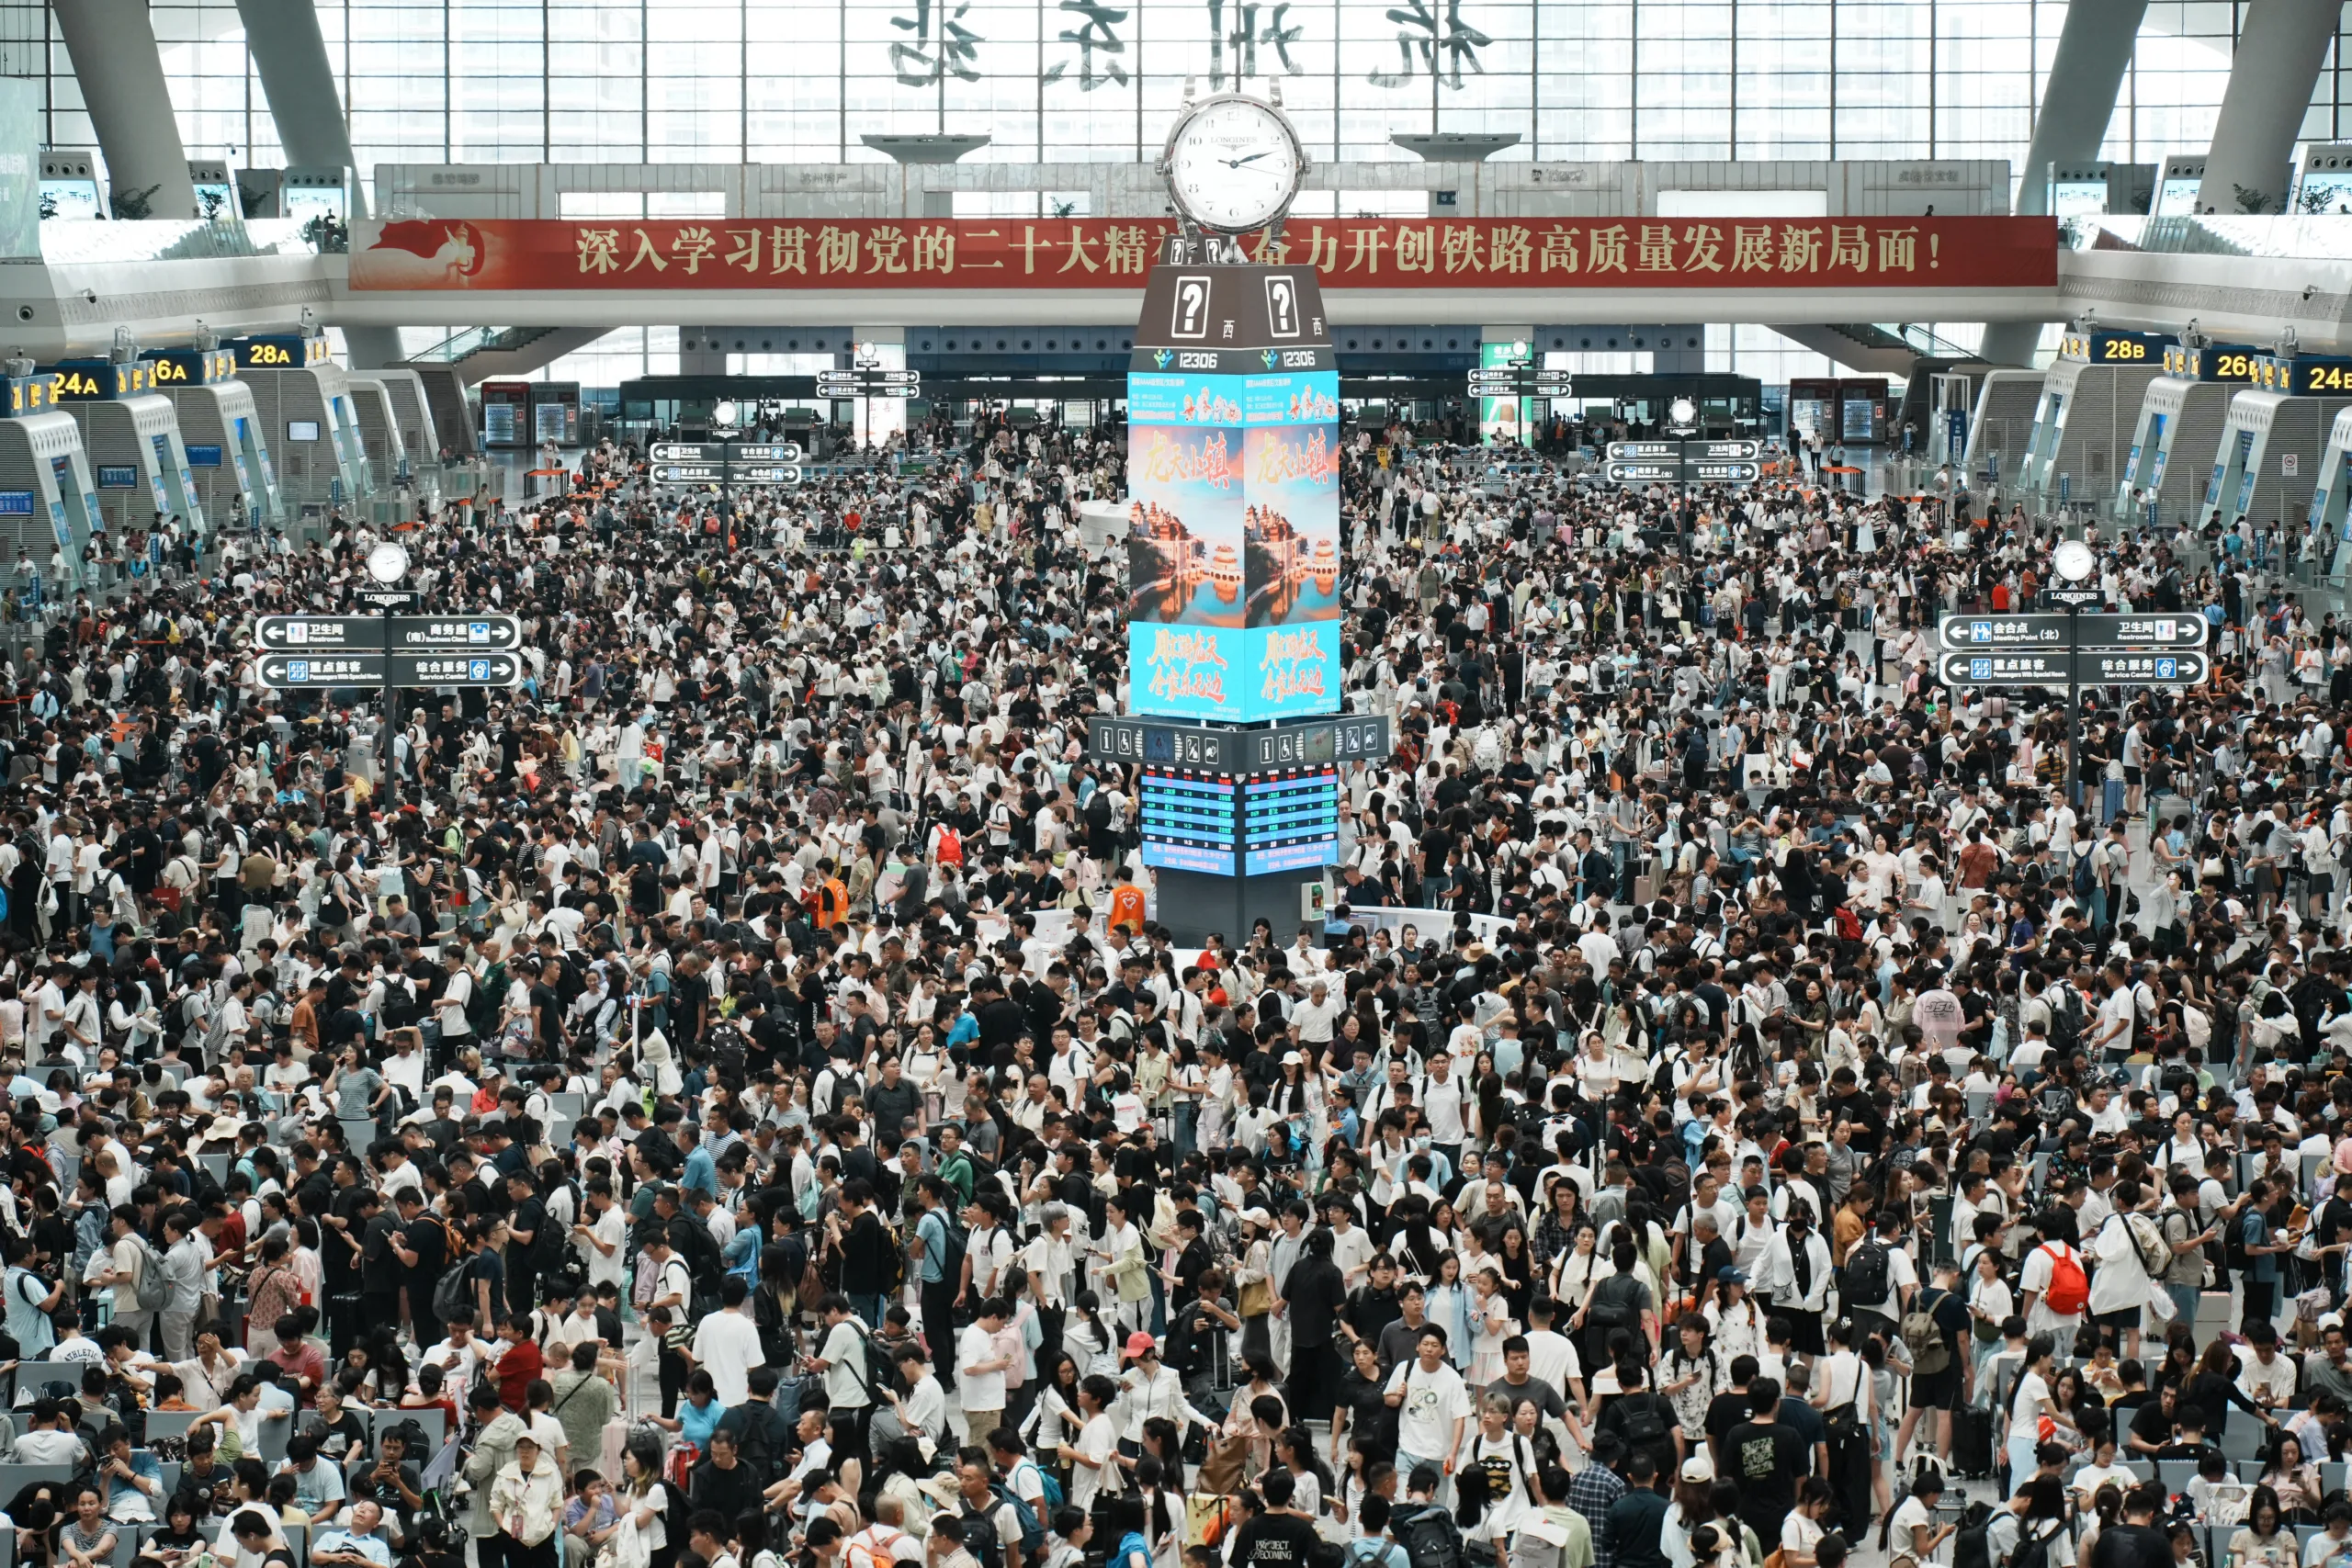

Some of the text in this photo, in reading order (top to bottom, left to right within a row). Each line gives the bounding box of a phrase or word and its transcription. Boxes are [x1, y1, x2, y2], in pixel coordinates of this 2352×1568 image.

[1189, 137, 1202, 145] 10
[1182, 159, 1191, 169] 9
[1229, 208, 1238, 217] 6
[1223, 320, 1235, 339] 西
[1312, 317, 1323, 336] 西
[250, 345, 290, 364] 28A
[2105, 340, 2145, 359] 28B
[1179, 353, 1218, 368] 12306
[1283, 351, 1316, 367] 12306
[154, 360, 187, 379] 6A
[54, 372, 98, 394] 24A
[1145, 429, 1230, 490] 龙天小镇
[1257, 427, 1329, 485] 龙天小镇
[364, 593, 411, 603] LONGINES
[2051, 592, 2098, 601] LONGINES
[309, 624, 345, 636] 卫生间
[430, 624, 468, 636] 商务座
[1994, 623, 2029, 635] 会合点
[2119, 622, 2154, 634] 卫生间
[2040, 629, 2060, 641] (北)
[310, 661, 361, 673] 重点旅客
[416, 661, 468, 673] 综合服务
[1994, 660, 2045, 671] 重点旅客
[2101, 660, 2154, 671] 综合服务
[64, 1348, 98, 1361] ATHLETIC
[1255, 1538, 1290, 1551] PROJECT
[1247, 1550, 1292, 1561] BECOMING
